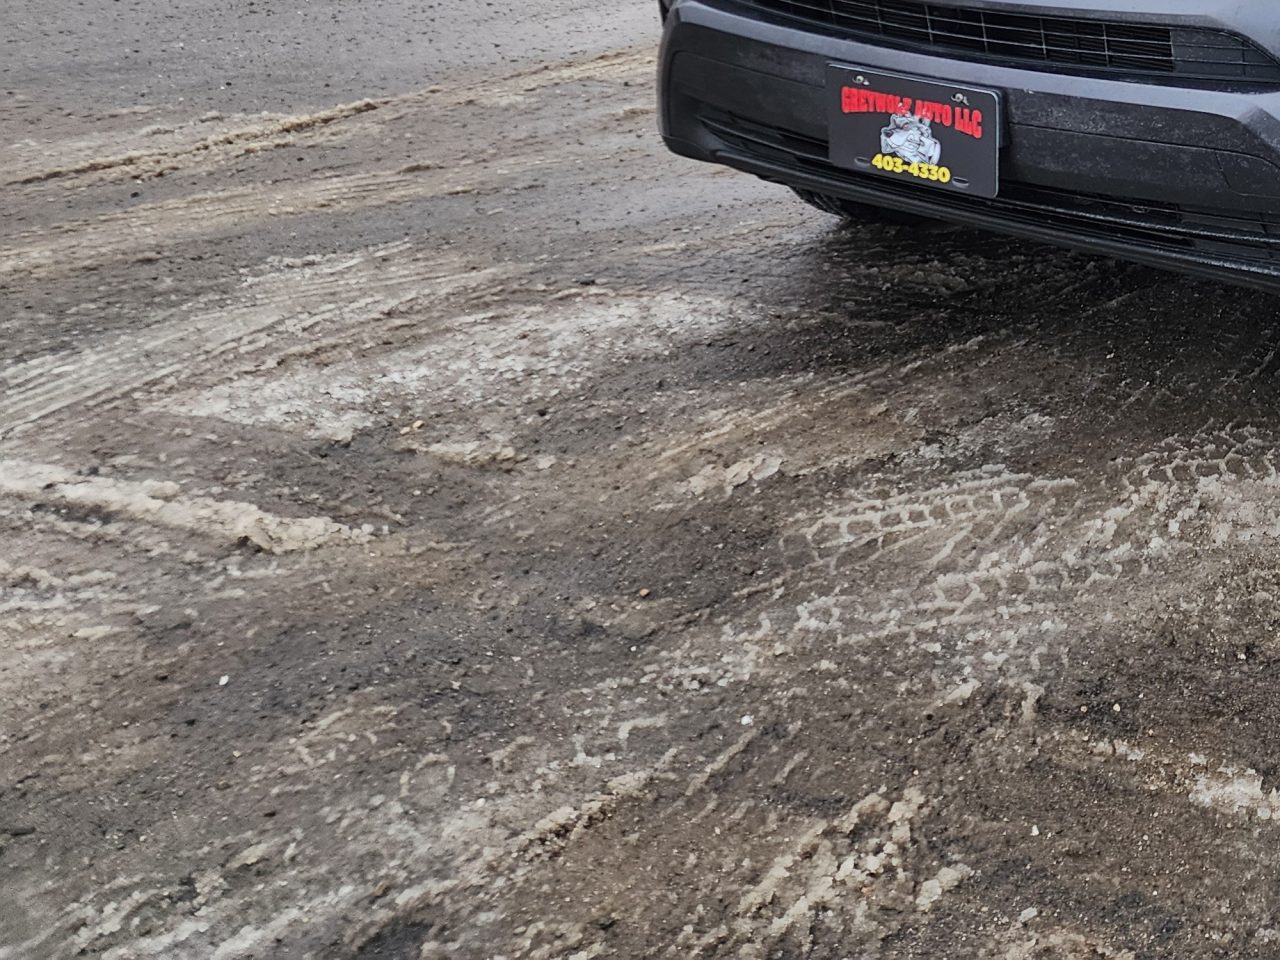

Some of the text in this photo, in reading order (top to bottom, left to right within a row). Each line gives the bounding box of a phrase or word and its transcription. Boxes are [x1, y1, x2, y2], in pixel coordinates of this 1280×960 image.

[841, 85, 983, 138] GREYWOLF AUTO LLC
[871, 153, 952, 183] 403-4330
